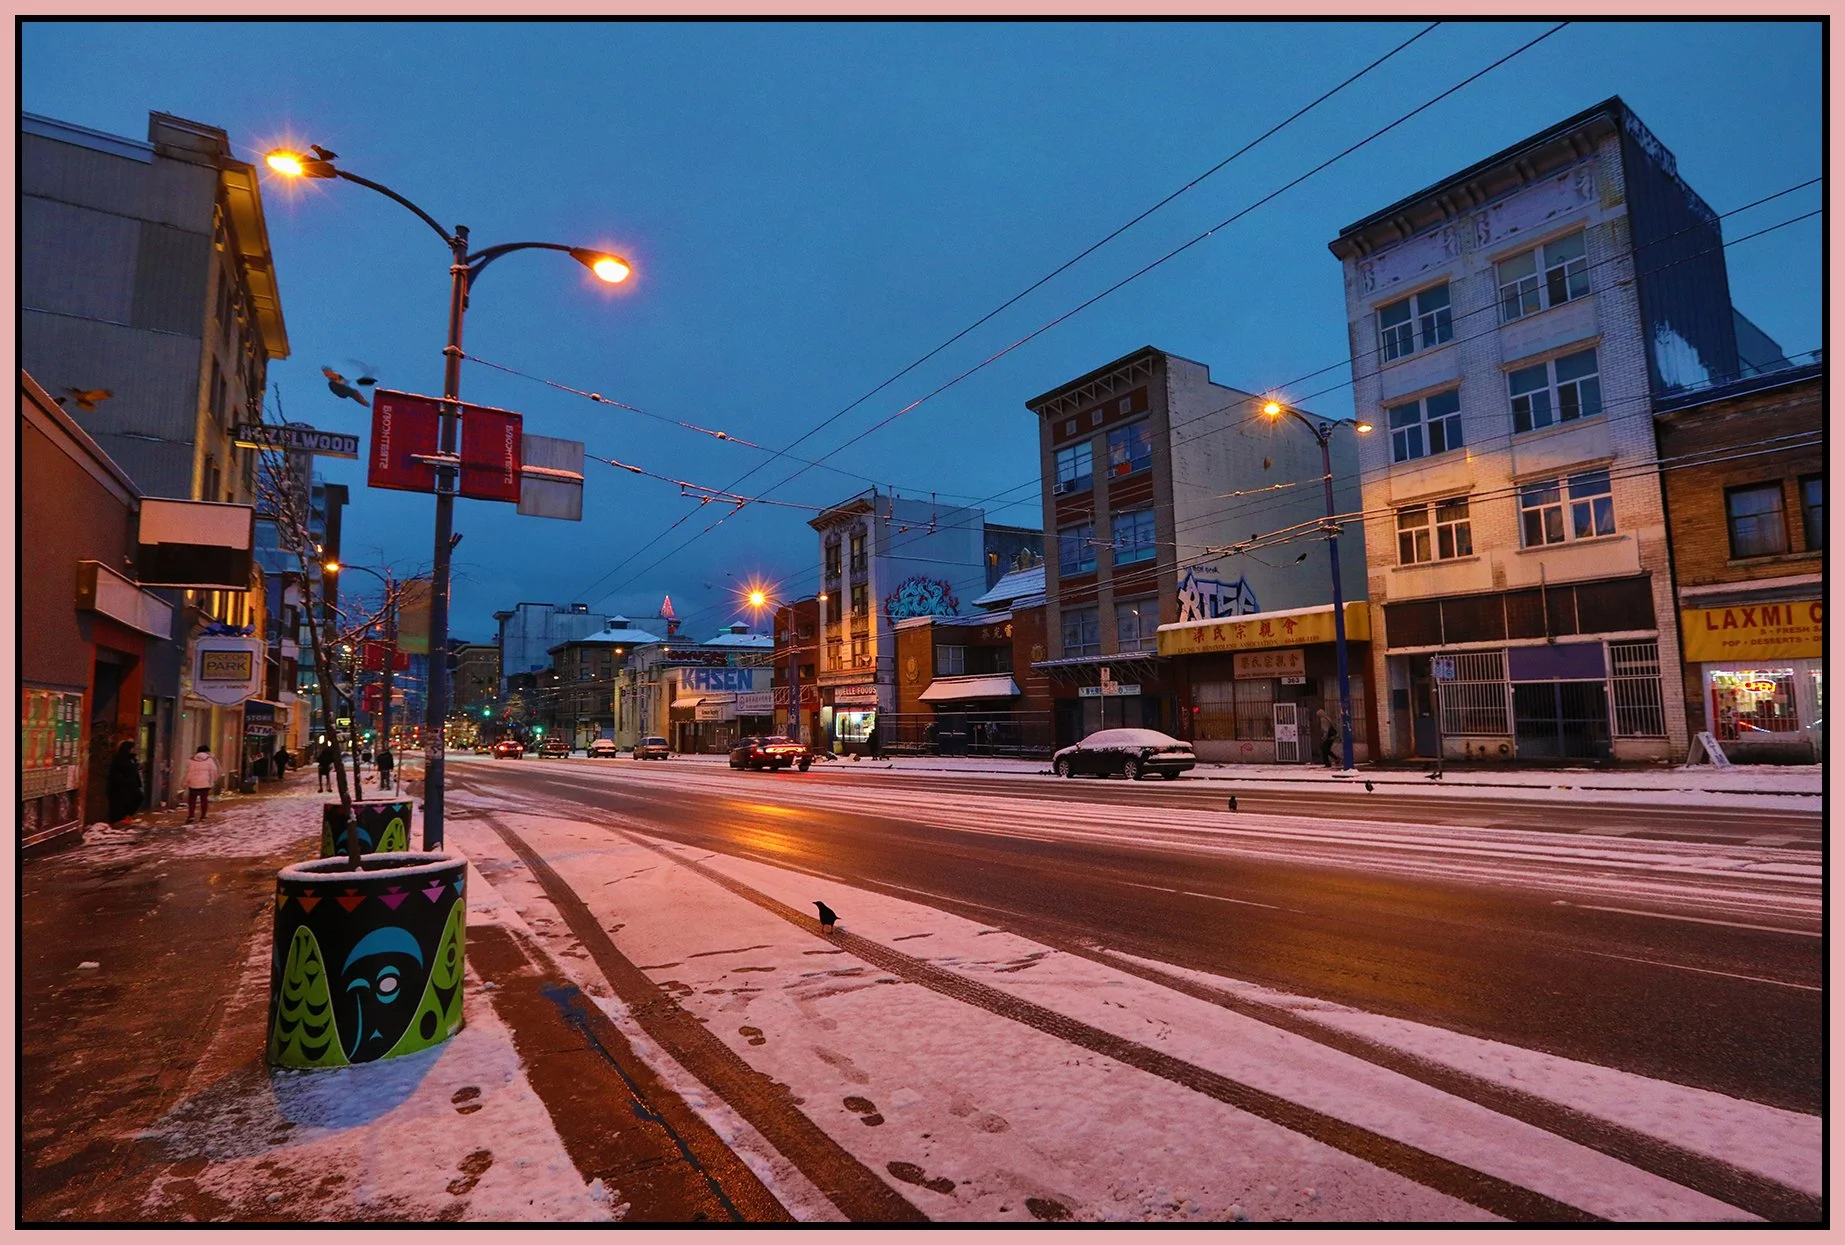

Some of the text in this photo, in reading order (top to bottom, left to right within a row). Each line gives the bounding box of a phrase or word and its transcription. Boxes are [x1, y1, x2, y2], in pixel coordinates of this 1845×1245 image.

[240, 425, 356, 453] HAZELWOOD
[1705, 605, 1792, 631] LAXMI
[1776, 626, 1810, 634] FRESH
[1240, 640, 1278, 649] ASSOCIATION
[1751, 636, 1801, 645] DESSERTS
[207, 661, 248, 671] PARK
[857, 686, 877, 695] FOODS
[1743, 682, 1776, 693] OPEN
